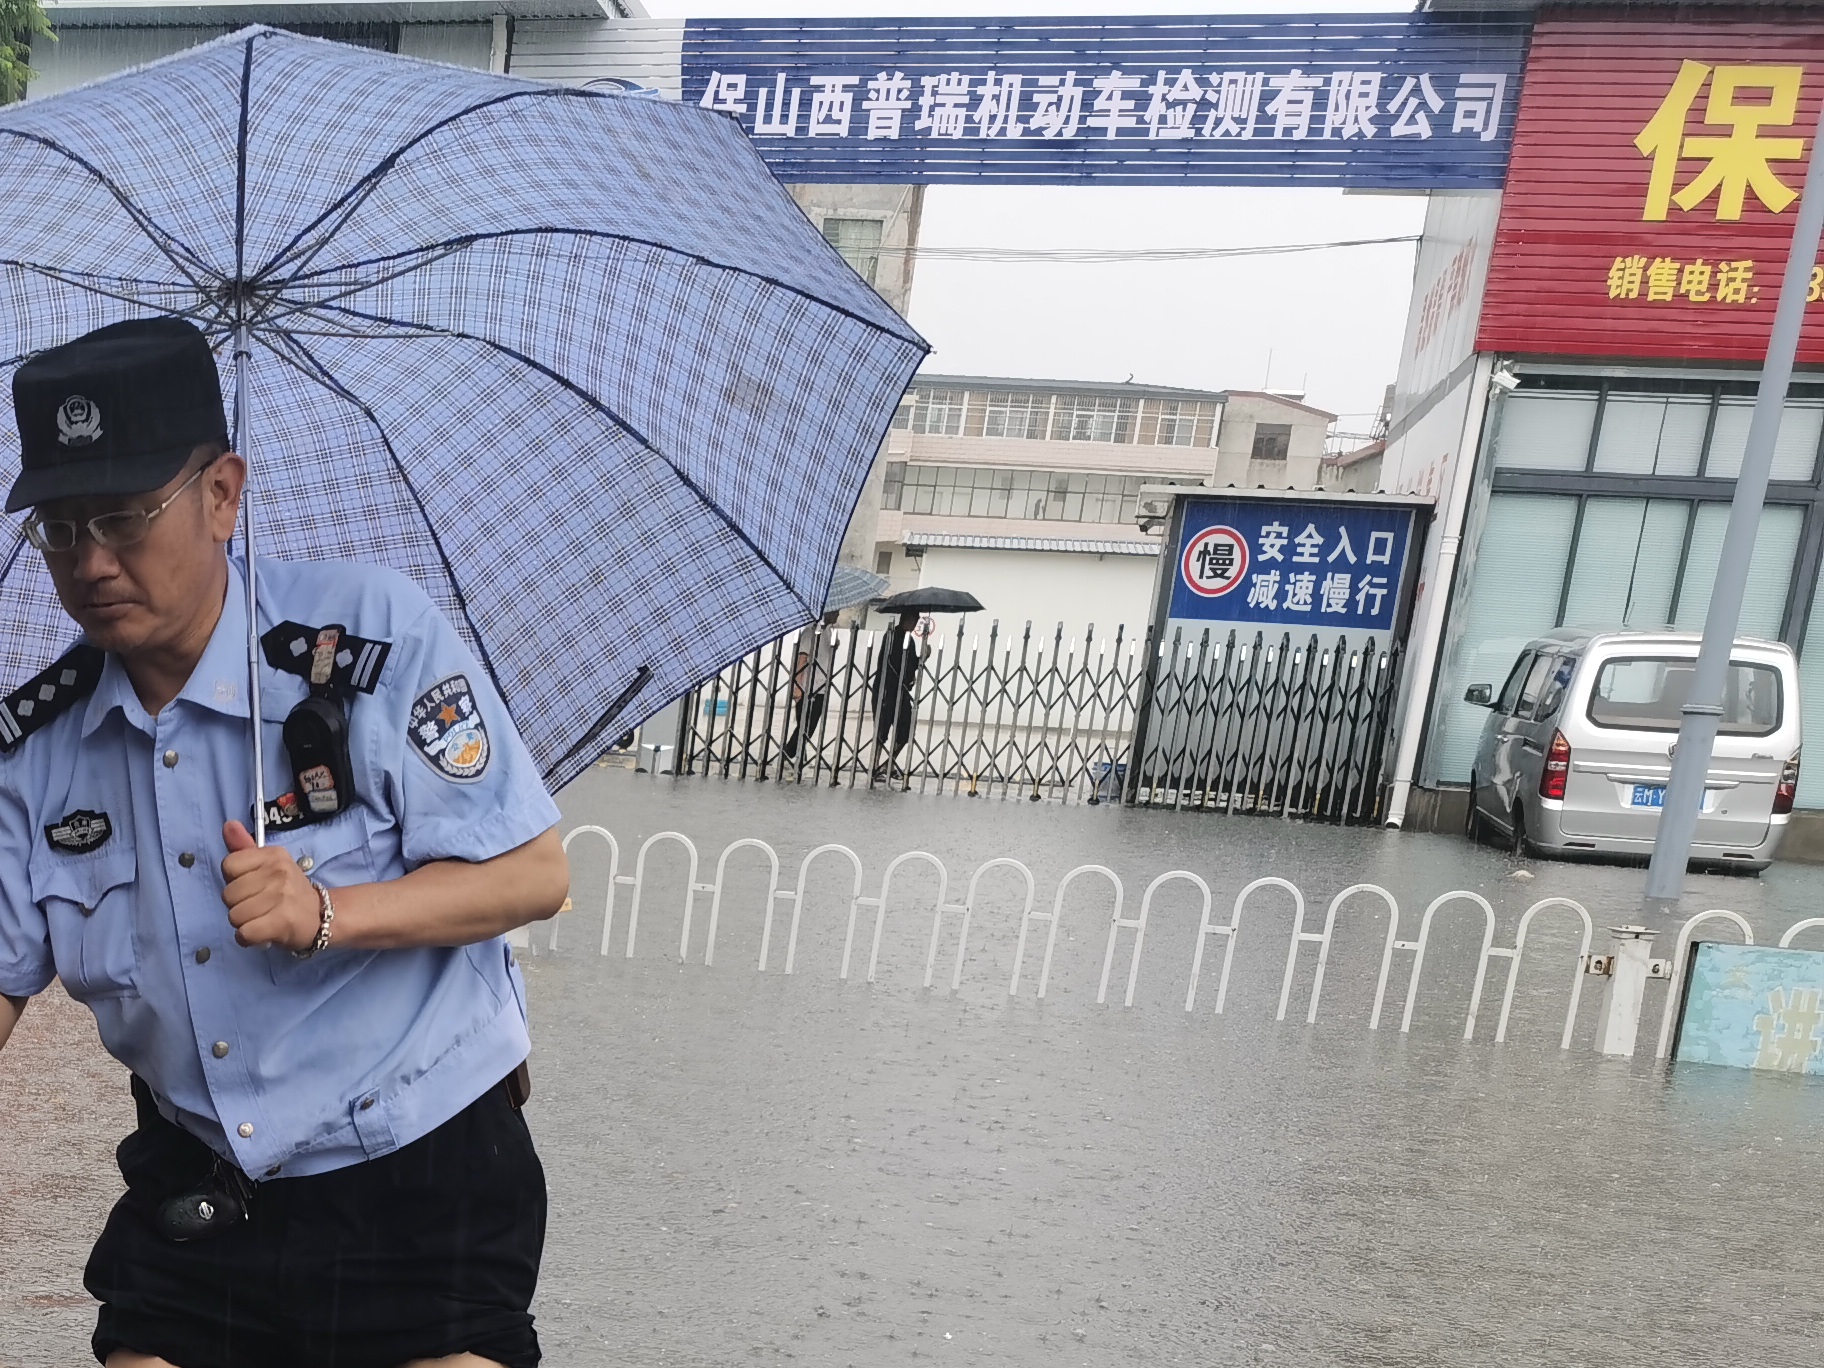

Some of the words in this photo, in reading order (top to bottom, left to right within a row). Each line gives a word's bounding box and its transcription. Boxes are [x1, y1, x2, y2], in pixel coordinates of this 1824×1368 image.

[699, 68, 1508, 142] 保山西普瑞机动车检测有限公司
[1633, 58, 1804, 222] 保
[1196, 541, 1236, 581] 慢
[1257, 521, 1395, 565] 安全入口
[1246, 569, 1388, 616] 减速慢行
[1634, 786, 1666, 807] 云M·Y
